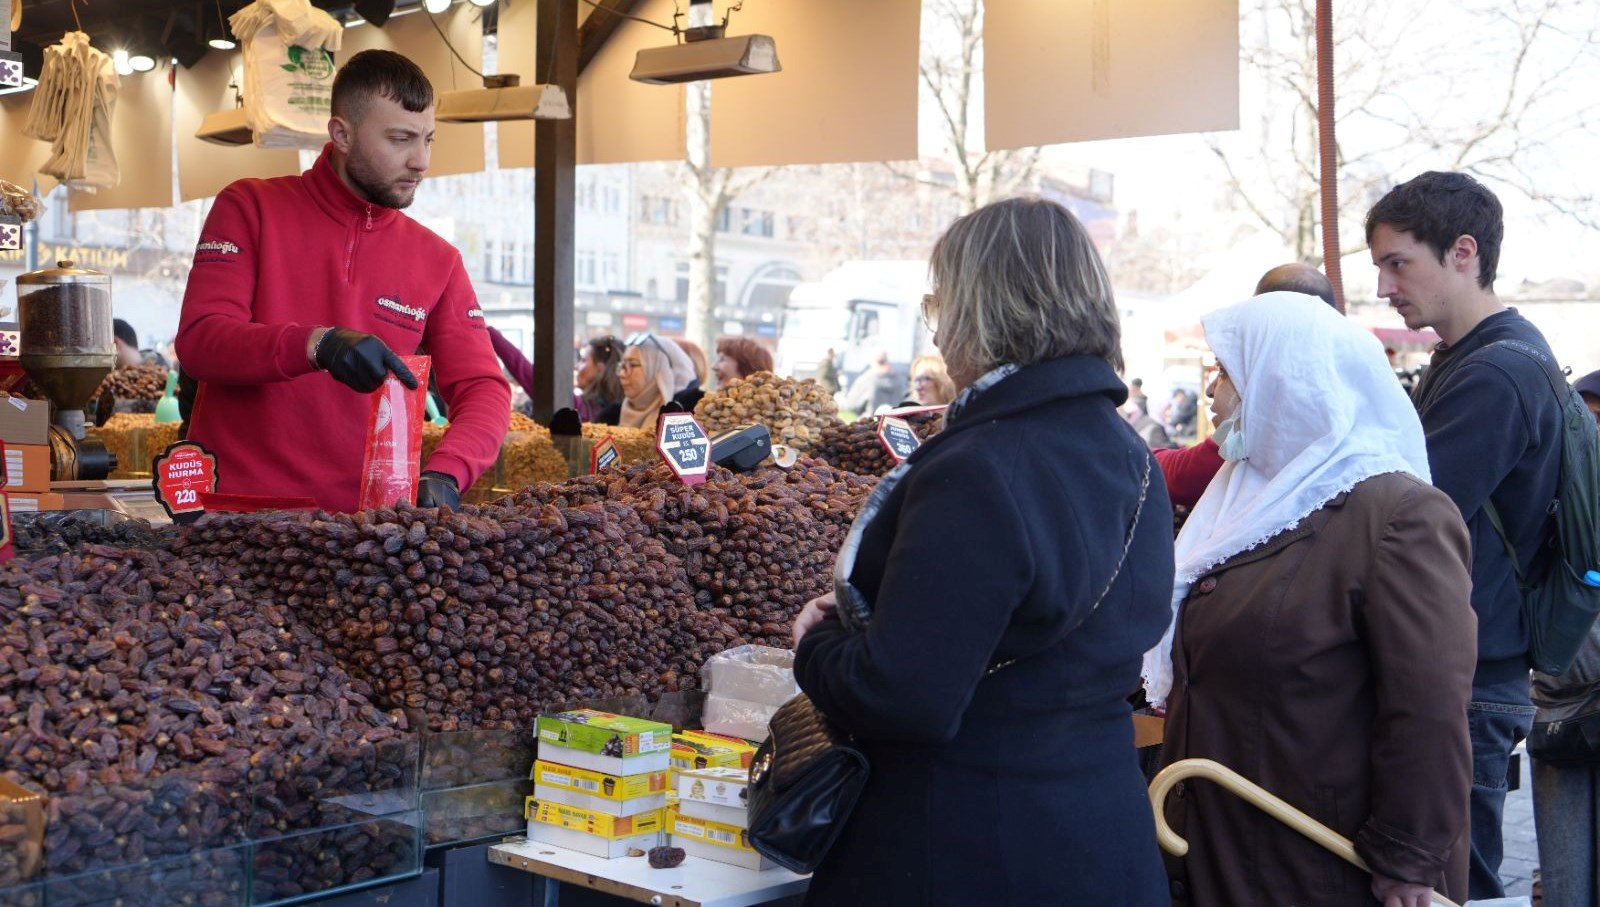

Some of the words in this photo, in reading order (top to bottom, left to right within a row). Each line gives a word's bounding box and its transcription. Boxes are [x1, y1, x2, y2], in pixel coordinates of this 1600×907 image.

[670, 424, 694, 434] SÜPER
[679, 448, 698, 462] 250
[169, 460, 203, 471] KUDÜS
[168, 468, 204, 479] HURMA
[175, 489, 196, 504] 220
